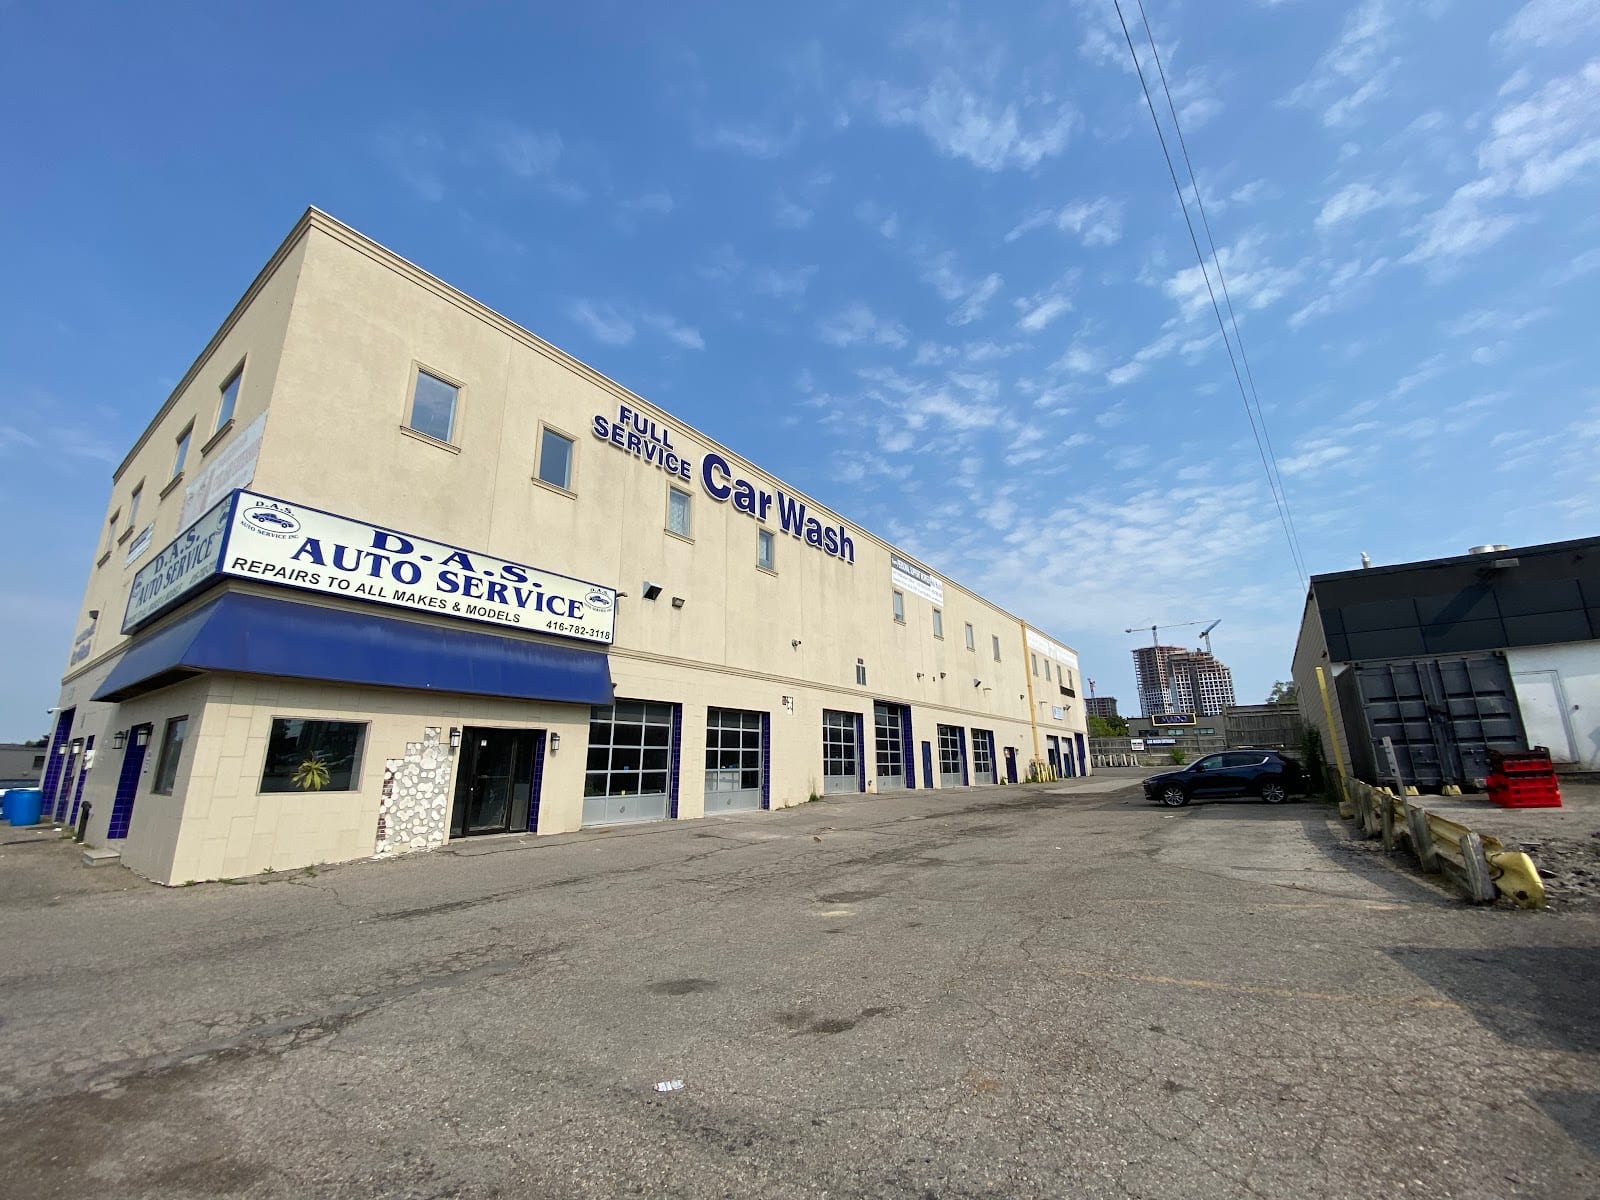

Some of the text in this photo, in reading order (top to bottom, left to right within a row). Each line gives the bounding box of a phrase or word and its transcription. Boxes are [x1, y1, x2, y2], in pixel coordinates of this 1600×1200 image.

[592, 415, 692, 480] SERVICE
[619, 405, 674, 450] FULL
[240, 520, 256, 532] AUTO
[257, 529, 287, 539] SERVICE
[255, 501, 295, 516] D.A.S.
[701, 453, 855, 563] Car Wash
[135, 573, 163, 609] AUTO
[163, 533, 216, 590] SERVICE
[154, 527, 200, 575] D.A.S.
[290, 537, 585, 620] AUTO SERVICE
[369, 530, 543, 588] D.A.S.
[231, 557, 321, 585] REPAIRS
[327, 576, 351, 590] TO
[354, 583, 387, 598] ALL
[392, 590, 448, 609] MAKES
[452, 602, 462, 612] &
[465, 604, 521, 623] MODELS
[546, 620, 611, 640] 416-782-3118
